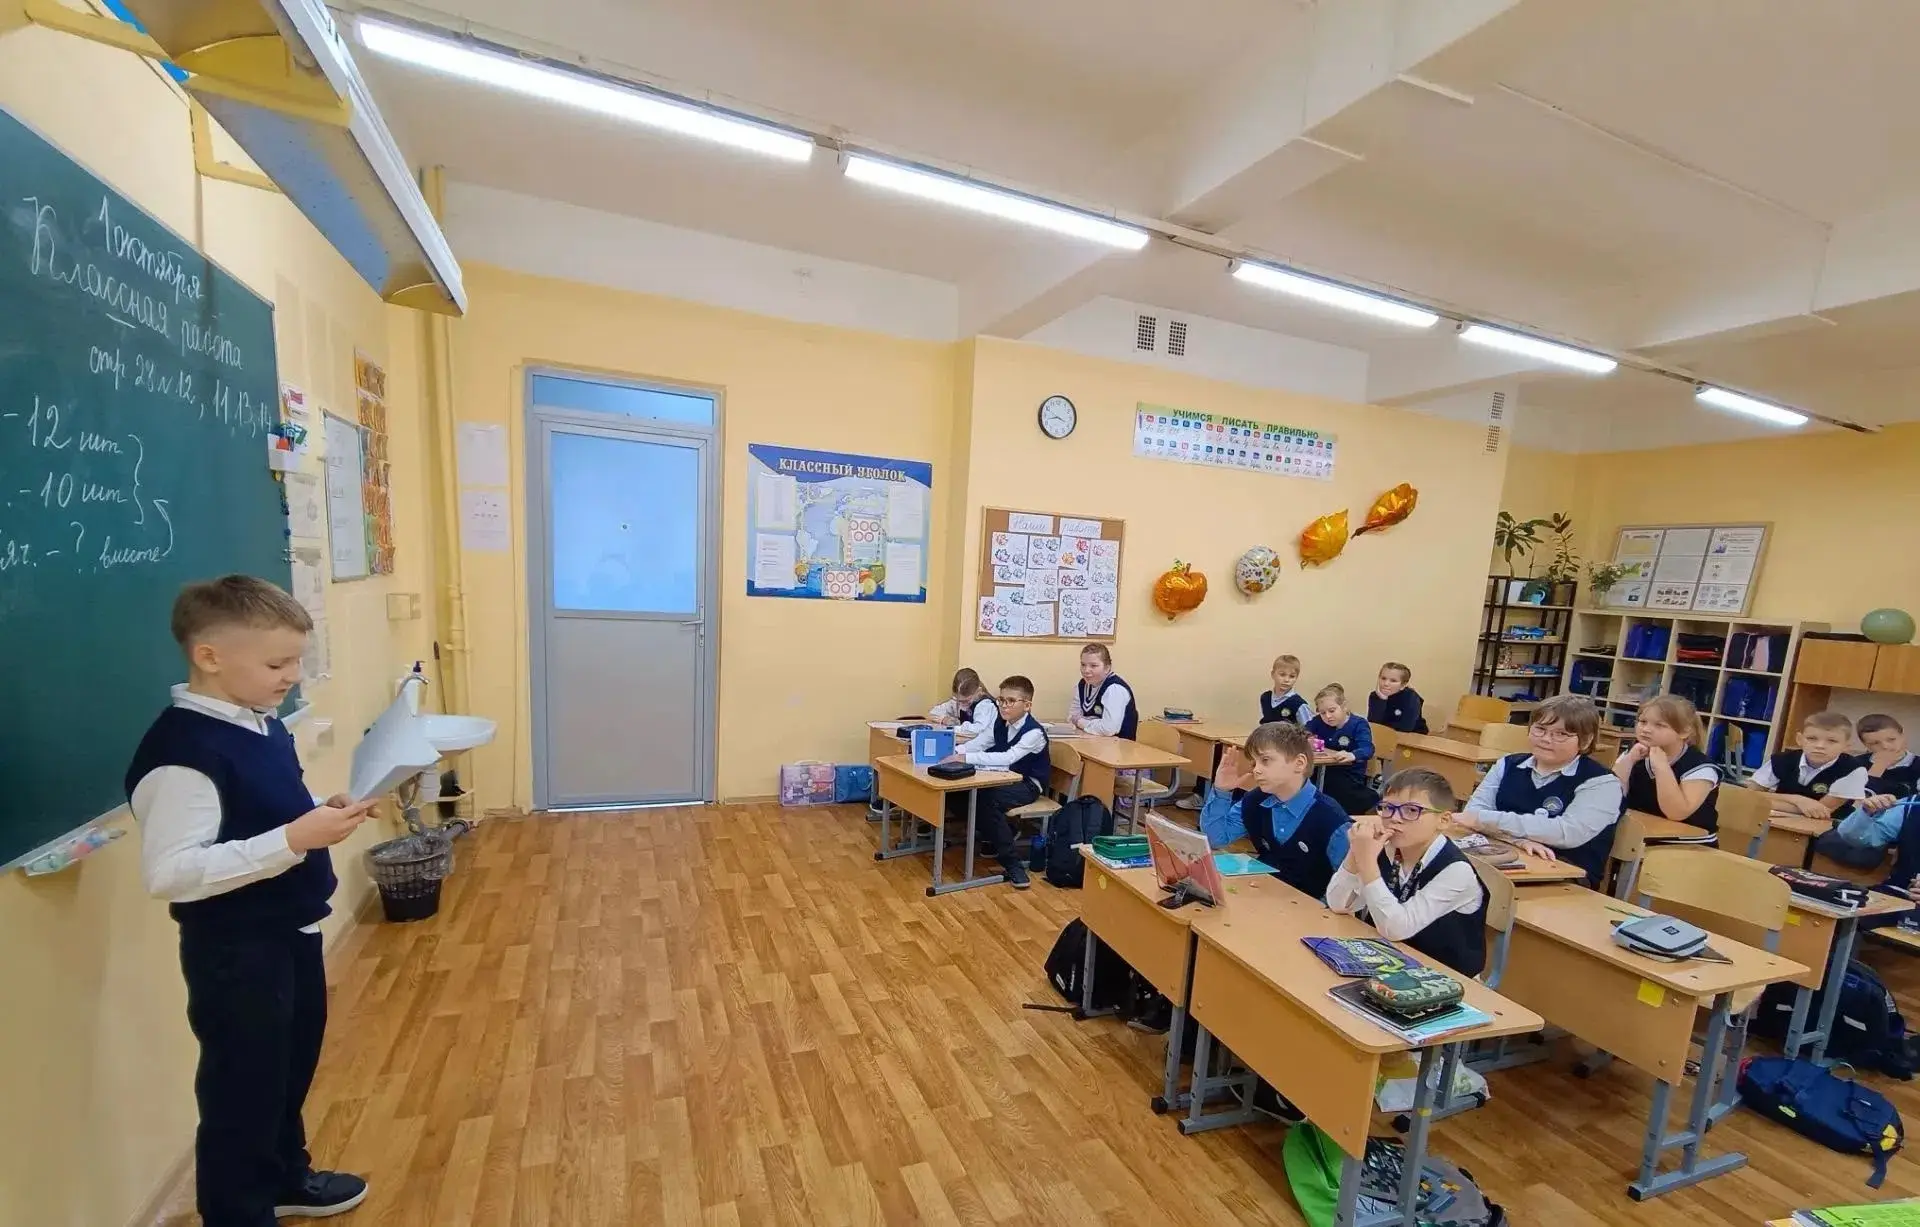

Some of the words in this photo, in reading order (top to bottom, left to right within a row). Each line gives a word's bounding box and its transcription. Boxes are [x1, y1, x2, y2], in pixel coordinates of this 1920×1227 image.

[23, 196, 170, 338] Классная
[181, 318, 243, 370] работа
[1173, 409, 1213, 422] УЧИМСЯ
[1222, 416, 1259, 430] ПИСАТЬ
[1267, 423, 1319, 440] ПРАВИЛЬНО
[779, 457, 854, 476] КЛАССНЫЙ
[857, 466, 907, 483] УГОЛОК
